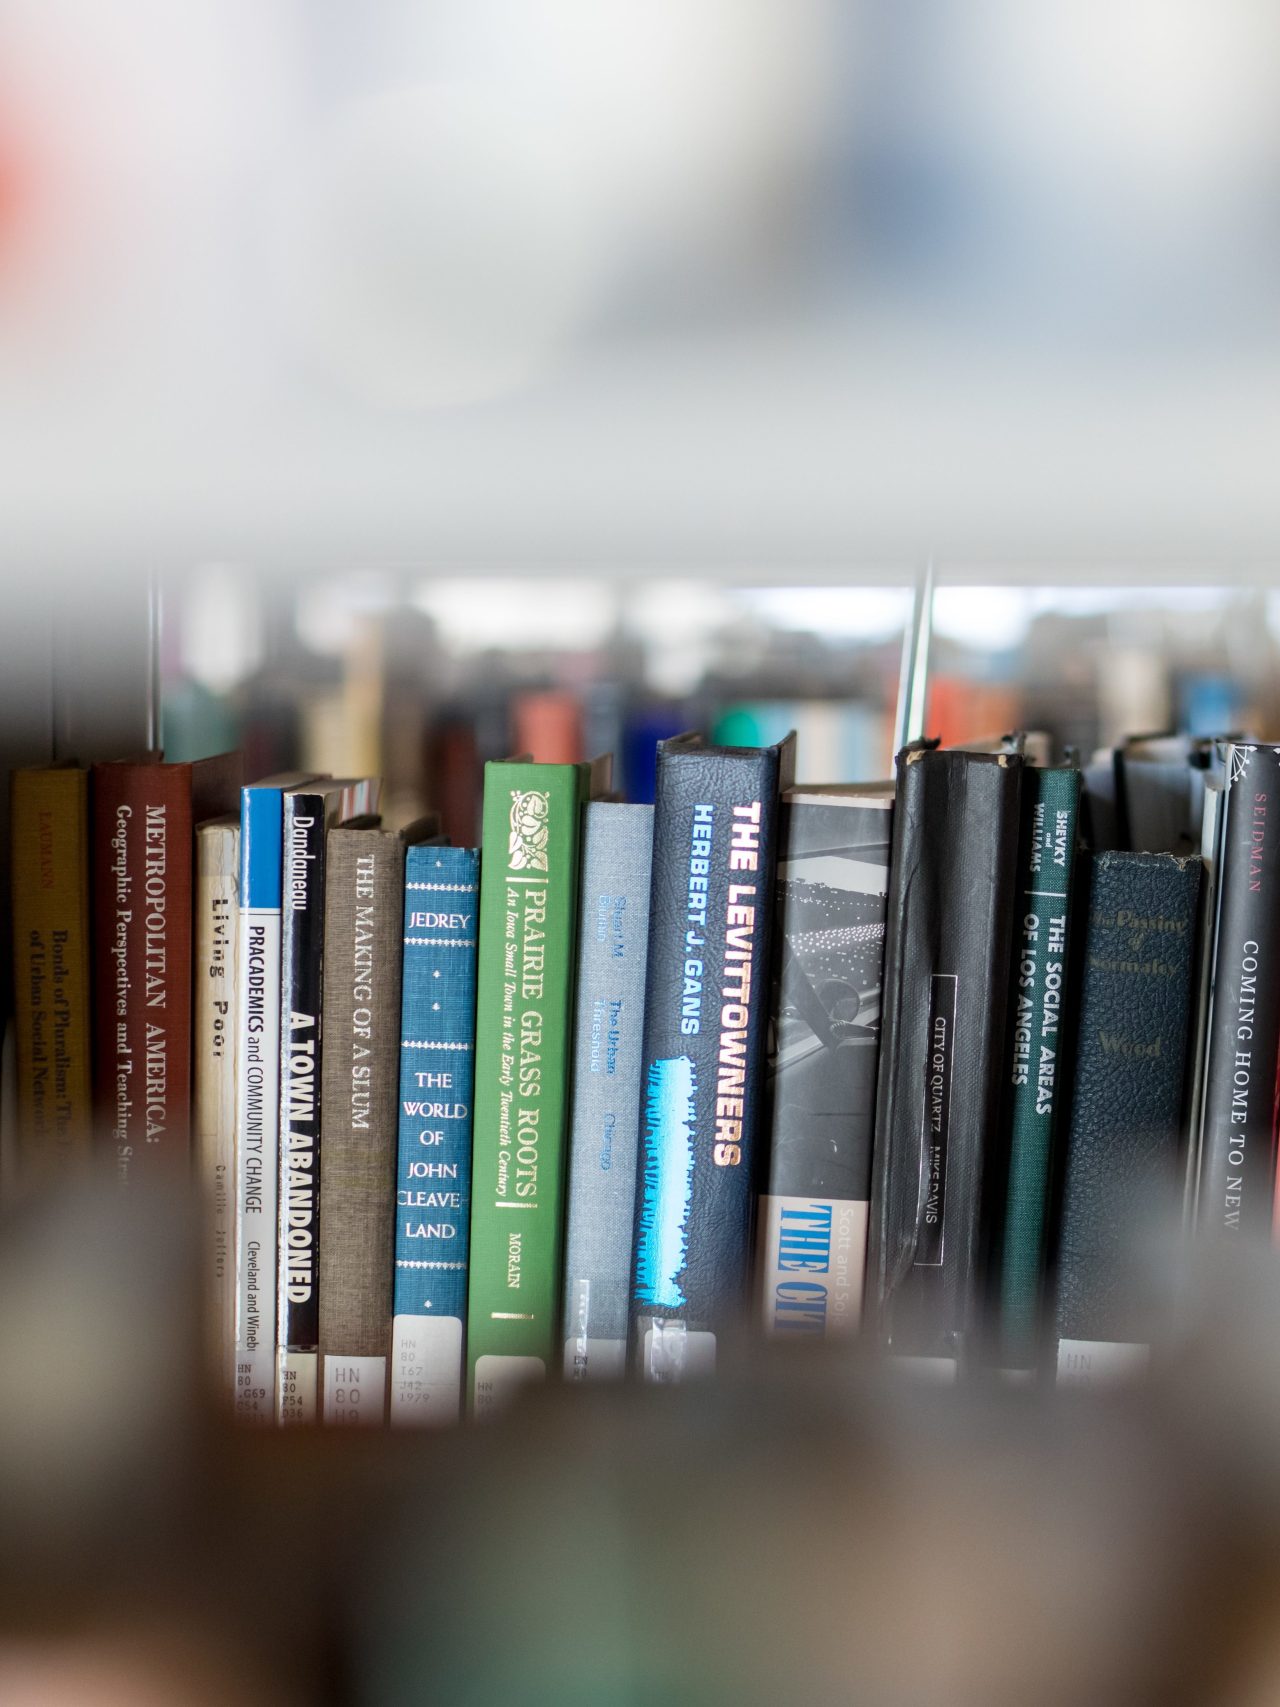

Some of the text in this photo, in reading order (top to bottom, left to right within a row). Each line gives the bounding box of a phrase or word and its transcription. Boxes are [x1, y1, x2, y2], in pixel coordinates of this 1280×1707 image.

[42, 811, 55, 890] LAUMANN
[293, 816, 315, 910] Dandaneau
[1032, 802, 1045, 872] WILLIAMS
[1053, 811, 1067, 867] SHEVKY
[1248, 793, 1266, 893] SEIDMAN
[408, 912, 470, 928] JEDREY
[683, 804, 713, 1035] HERBERT J. GANS
[30, 930, 48, 1062] of Urban Social
[113, 804, 132, 1138] Geographic Perspectives and Teaching
[146, 804, 166, 1143] METROPOLITAN AMERICA:
[210, 899, 229, 1057] Living Poor
[352, 854, 375, 1129] THE MAKING OF A SLUM
[715, 802, 761, 1167] THE LEVITTOWNERS
[1014, 914, 1040, 1085] OF LOS ANGELES
[53, 930, 72, 1099] Bonds of Pluralism:
[496, 887, 519, 1197] An Iowa Small Town in the Early Twentieth Century
[516, 889, 546, 1197] PRAIRIE GRASS ROOTS
[591, 999, 606, 1072] Threshold
[606, 1000, 622, 1074] The Urban
[1035, 915, 1065, 1115] THE SOCIAL AREAS
[246, 926, 264, 1214] PRACADEMICS and COMMUNITY CHANGE
[414, 1073, 453, 1088] THE
[931, 1016, 946, 1133] CITY OF QUARTZ
[1225, 940, 1258, 1231] COMING HOME TO NEW
[402, 1102, 468, 1118] WORLD
[419, 1130, 444, 1145] OF
[601, 1113, 616, 1171] Chicago
[216, 1165, 227, 1215] Camille
[288, 1011, 315, 1303] A TOWN ABANDONED
[407, 1163, 458, 1178] JOHN
[405, 1223, 456, 1238] LAND
[779, 1205, 832, 1274] THE
[926, 1183, 938, 1224] DAVIS
[248, 1241, 260, 1314] Cleveland and
[508, 1233, 521, 1289] MORAIN
[837, 1208, 853, 1285] Scott and
[335, 1368, 361, 1383] HN
[335, 1389, 361, 1402] 80
